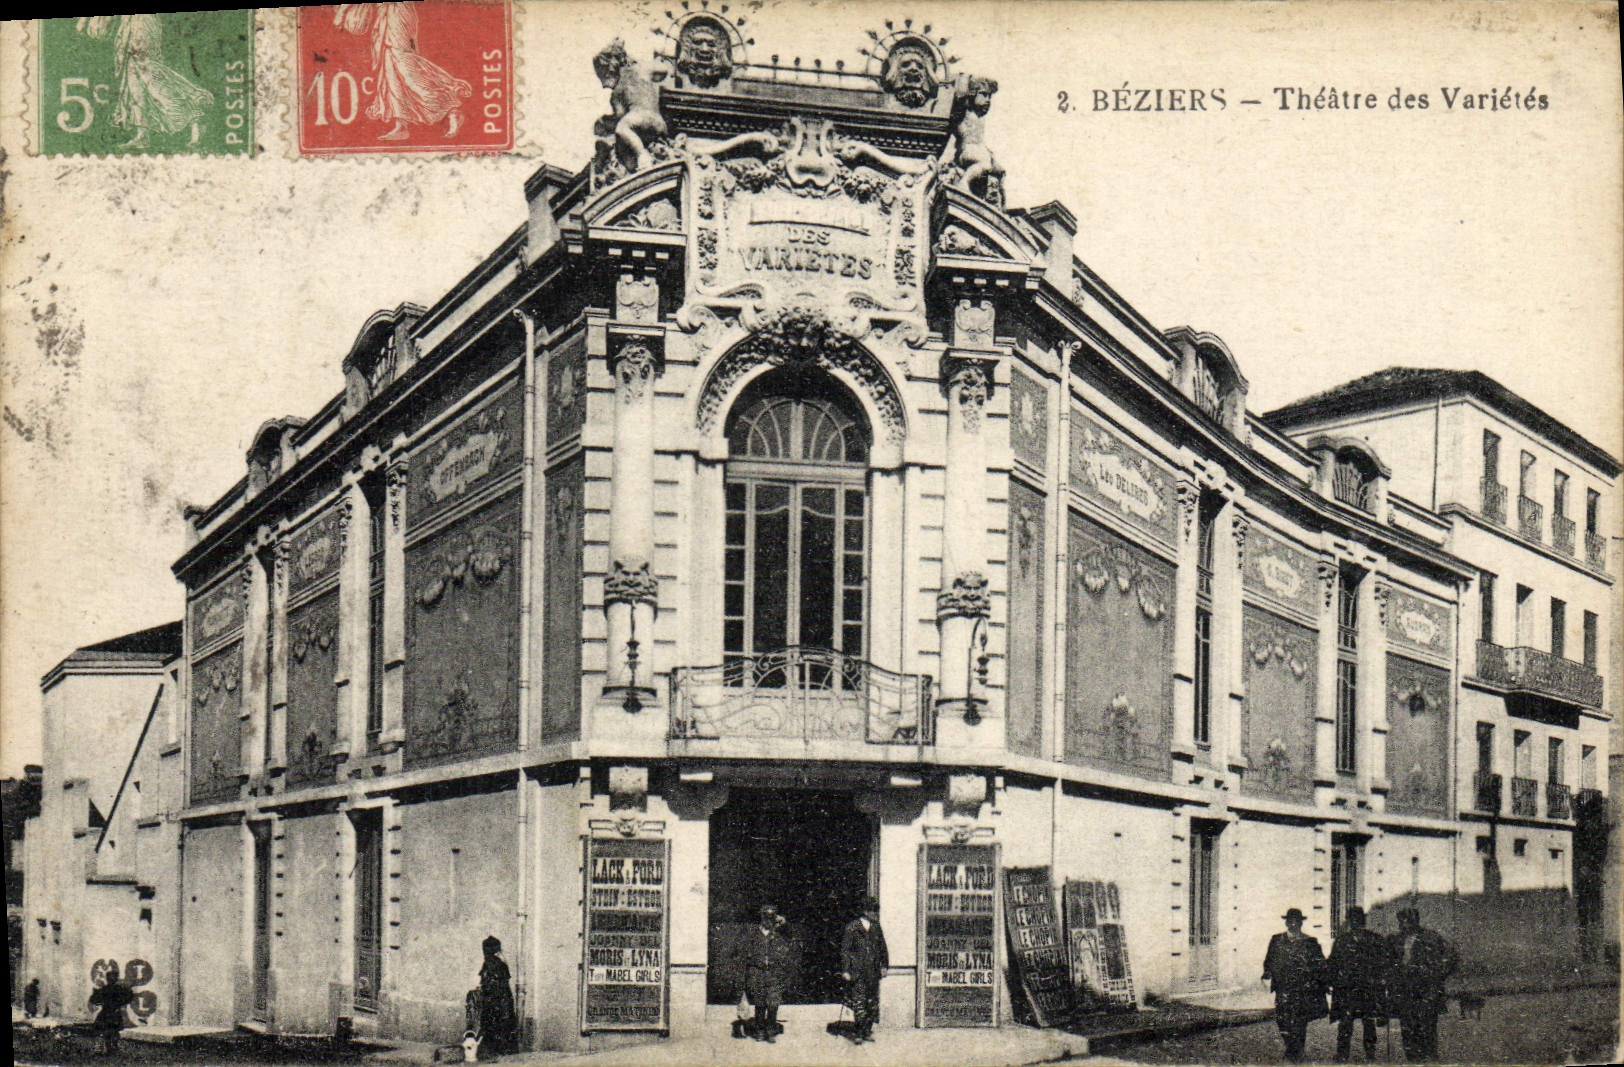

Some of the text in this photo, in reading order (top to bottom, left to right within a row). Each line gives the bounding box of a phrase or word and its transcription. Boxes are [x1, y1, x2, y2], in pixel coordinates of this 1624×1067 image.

[483, 48, 503, 134] POSTES
[225, 58, 244, 145] POSTES
[788, 227, 831, 246] DES
[592, 858, 624, 885] LACK
[631, 859, 663, 885] FORD
[928, 865, 957, 890] LACK
[964, 866, 993, 890] FORD
[590, 948, 623, 966] MORIS
[631, 949, 660, 967] LYNA
[965, 953, 992, 970] LYNA
[606, 968, 633, 982] MABEL
[635, 969, 661, 983] GIRLS
[942, 972, 967, 984] MABEL
[970, 972, 993, 984] GIRLS
